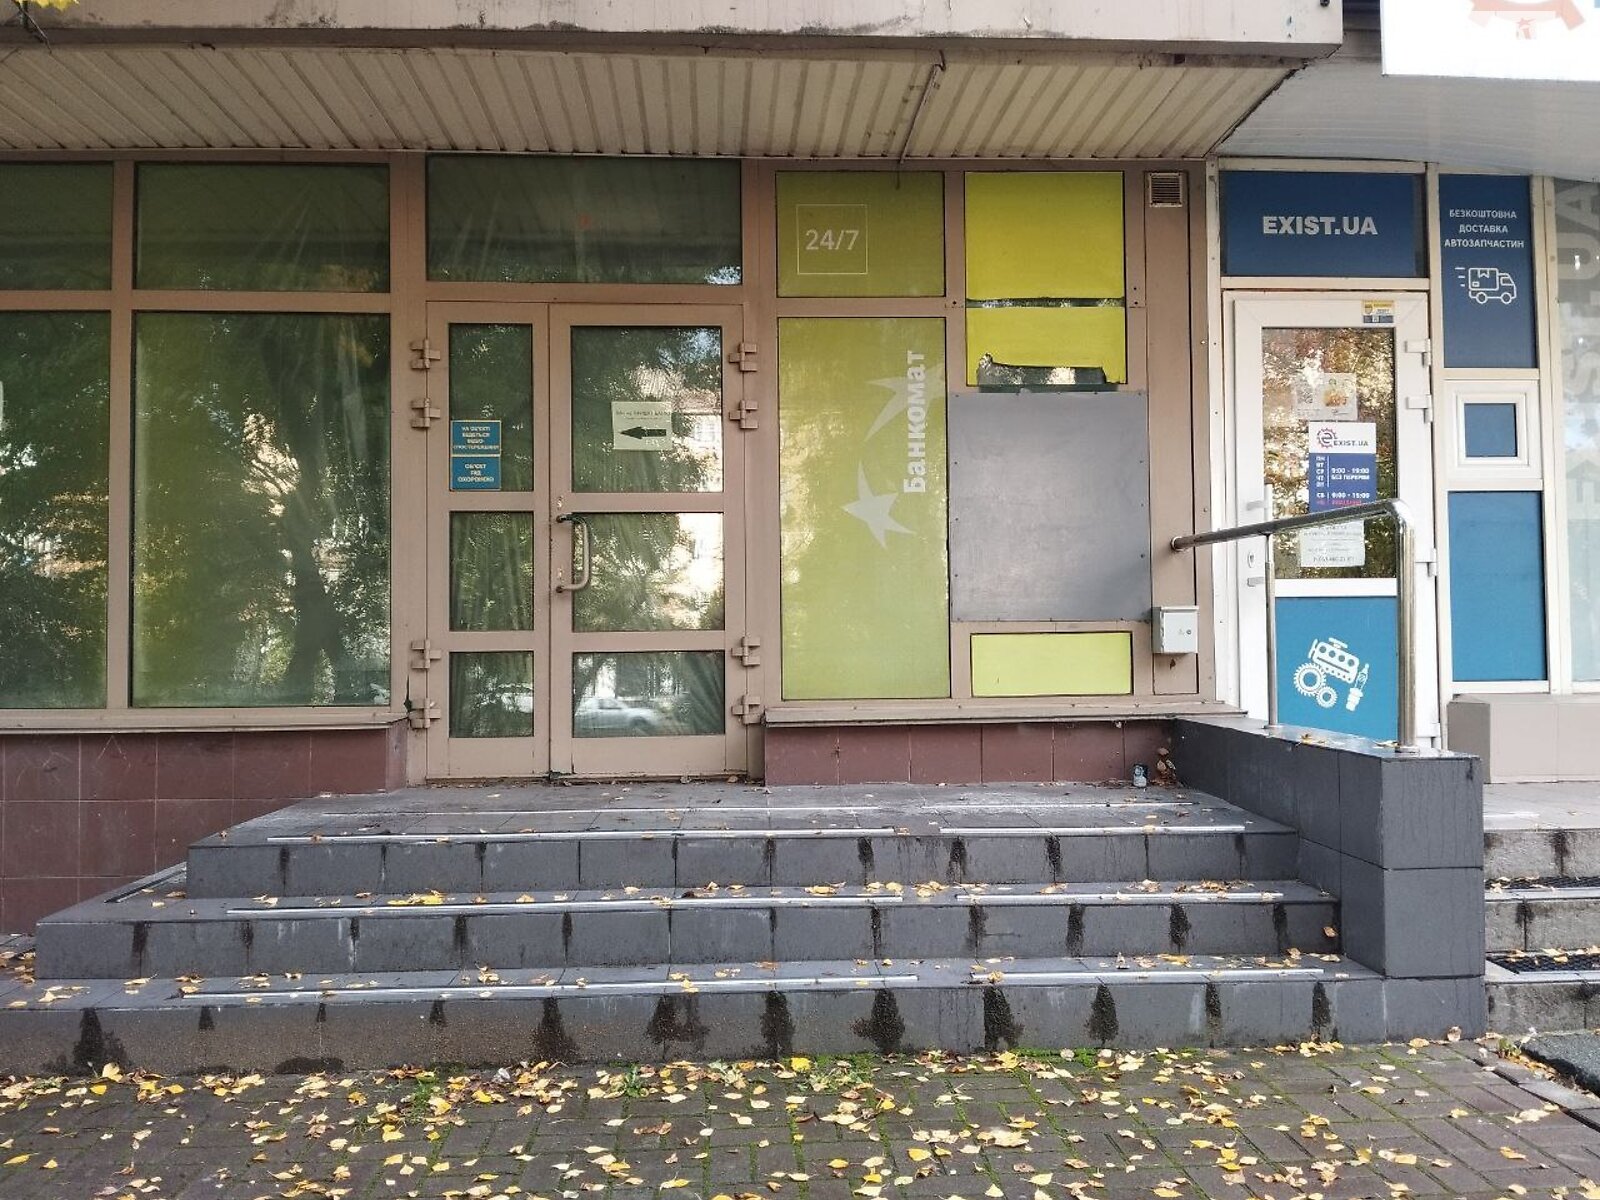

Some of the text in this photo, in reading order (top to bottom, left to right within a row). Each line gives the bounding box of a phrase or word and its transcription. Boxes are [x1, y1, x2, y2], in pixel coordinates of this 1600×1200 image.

[1449, 209, 1517, 219] БЕЗКОШТОВНА
[1263, 216, 1378, 235] EXIST.UA
[1459, 224, 1508, 233] ДОСТАВКА
[805, 229, 860, 250] 24/7
[1444, 239, 1525, 248] АВТОЗАПЧАСТИН
[903, 350, 926, 493] Банкомат
